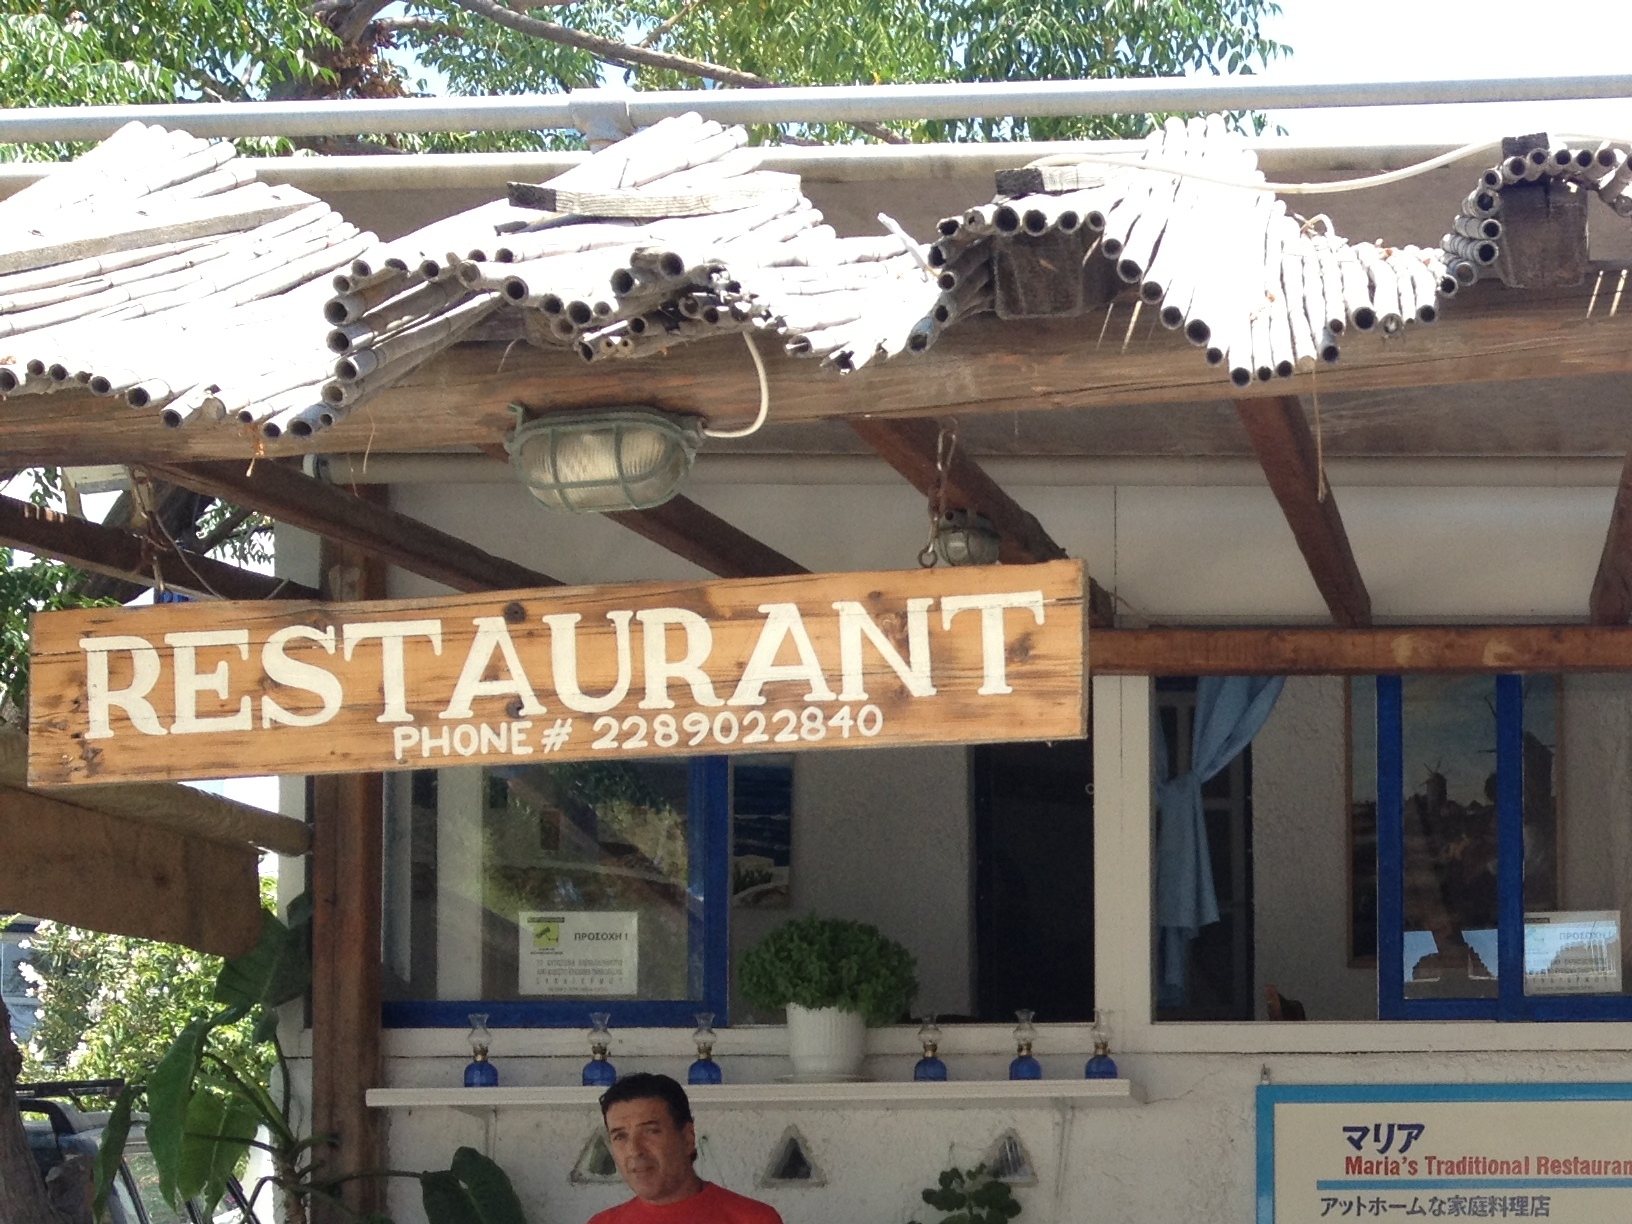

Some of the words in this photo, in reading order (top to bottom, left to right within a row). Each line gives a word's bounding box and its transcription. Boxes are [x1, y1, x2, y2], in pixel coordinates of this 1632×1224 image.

[79, 590, 1047, 739] RESTAURANT
[393, 722, 533, 760] PHONE
[541, 718, 573, 753] #
[591, 704, 884, 750] 2289022840
[1342, 1122, 1427, 1154] マリア
[1344, 1156, 1418, 1176] Maria's
[1425, 1156, 1530, 1176] Traditional
[1320, 1195, 1551, 1218] アットホームな家庭料理店
